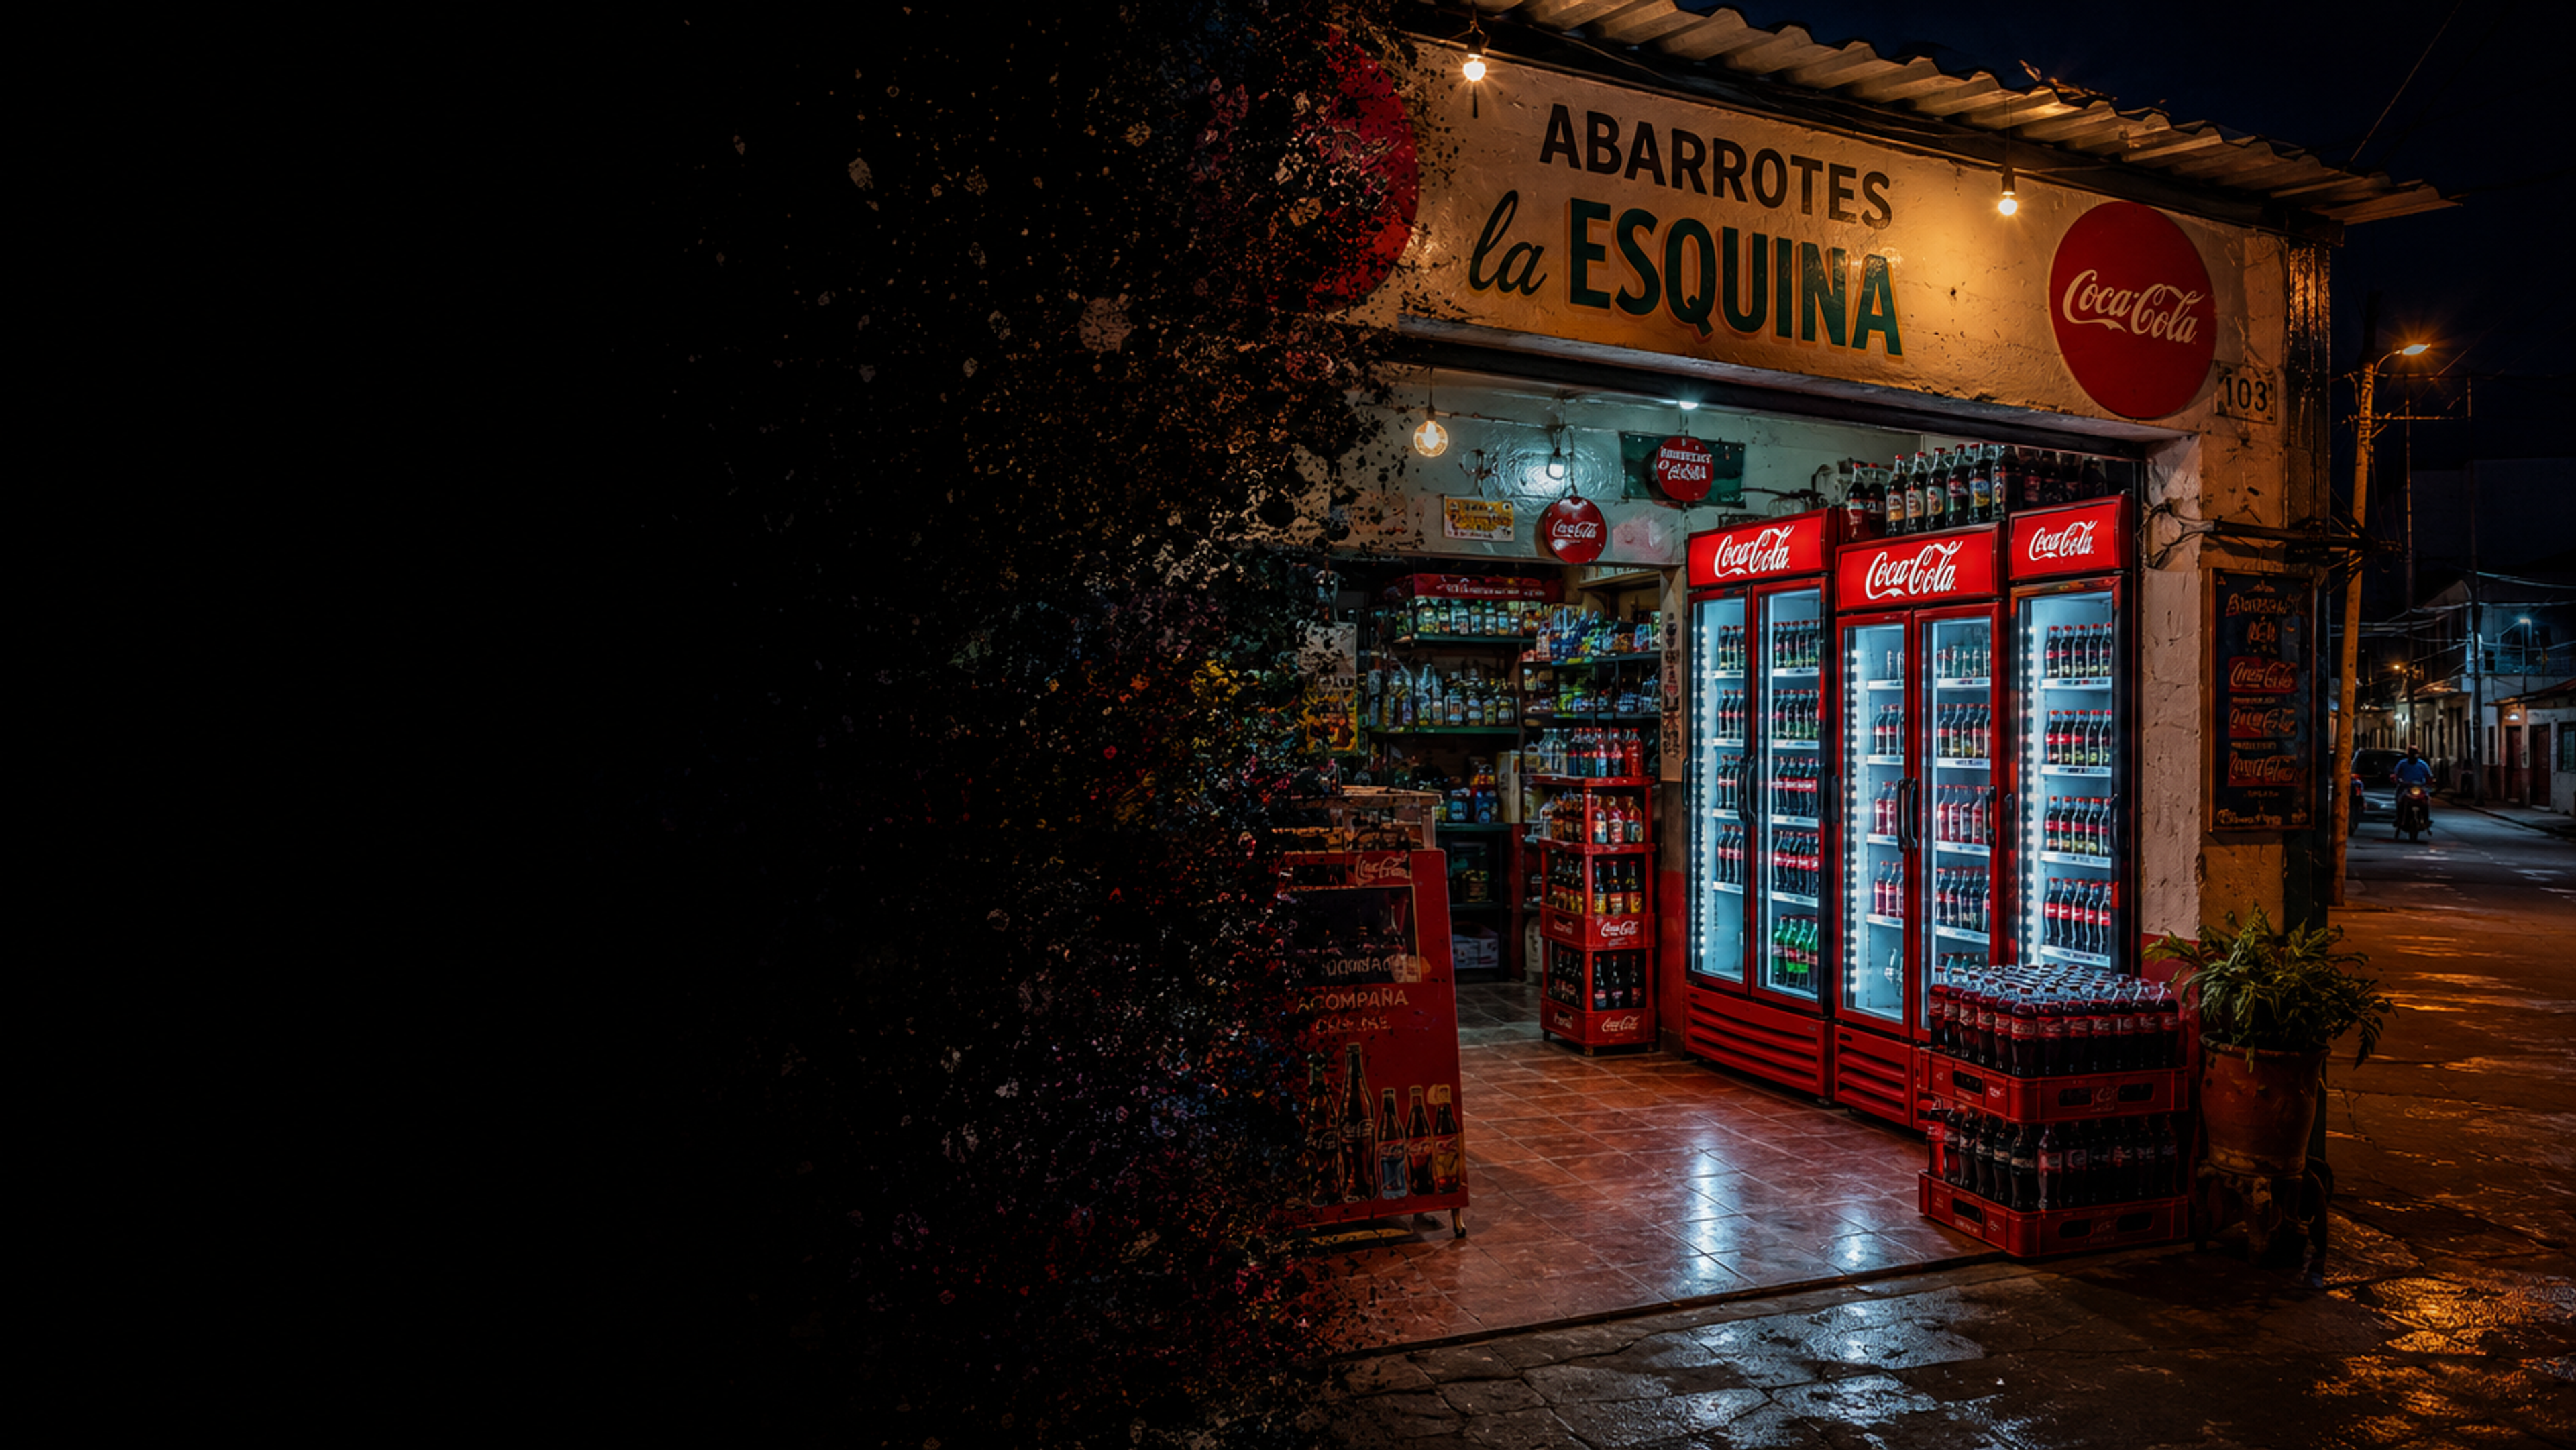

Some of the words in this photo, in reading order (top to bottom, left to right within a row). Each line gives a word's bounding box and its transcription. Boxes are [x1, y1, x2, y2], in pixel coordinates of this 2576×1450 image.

[1539, 103, 1892, 230] ABARROTES
[1468, 189, 1548, 297] la
[1567, 197, 1904, 359] ESQUINA
[2062, 269, 2205, 344] Coca-Cola
[2225, 376, 2267, 412] 103
[1865, 540, 1964, 600] Coca-Cola
